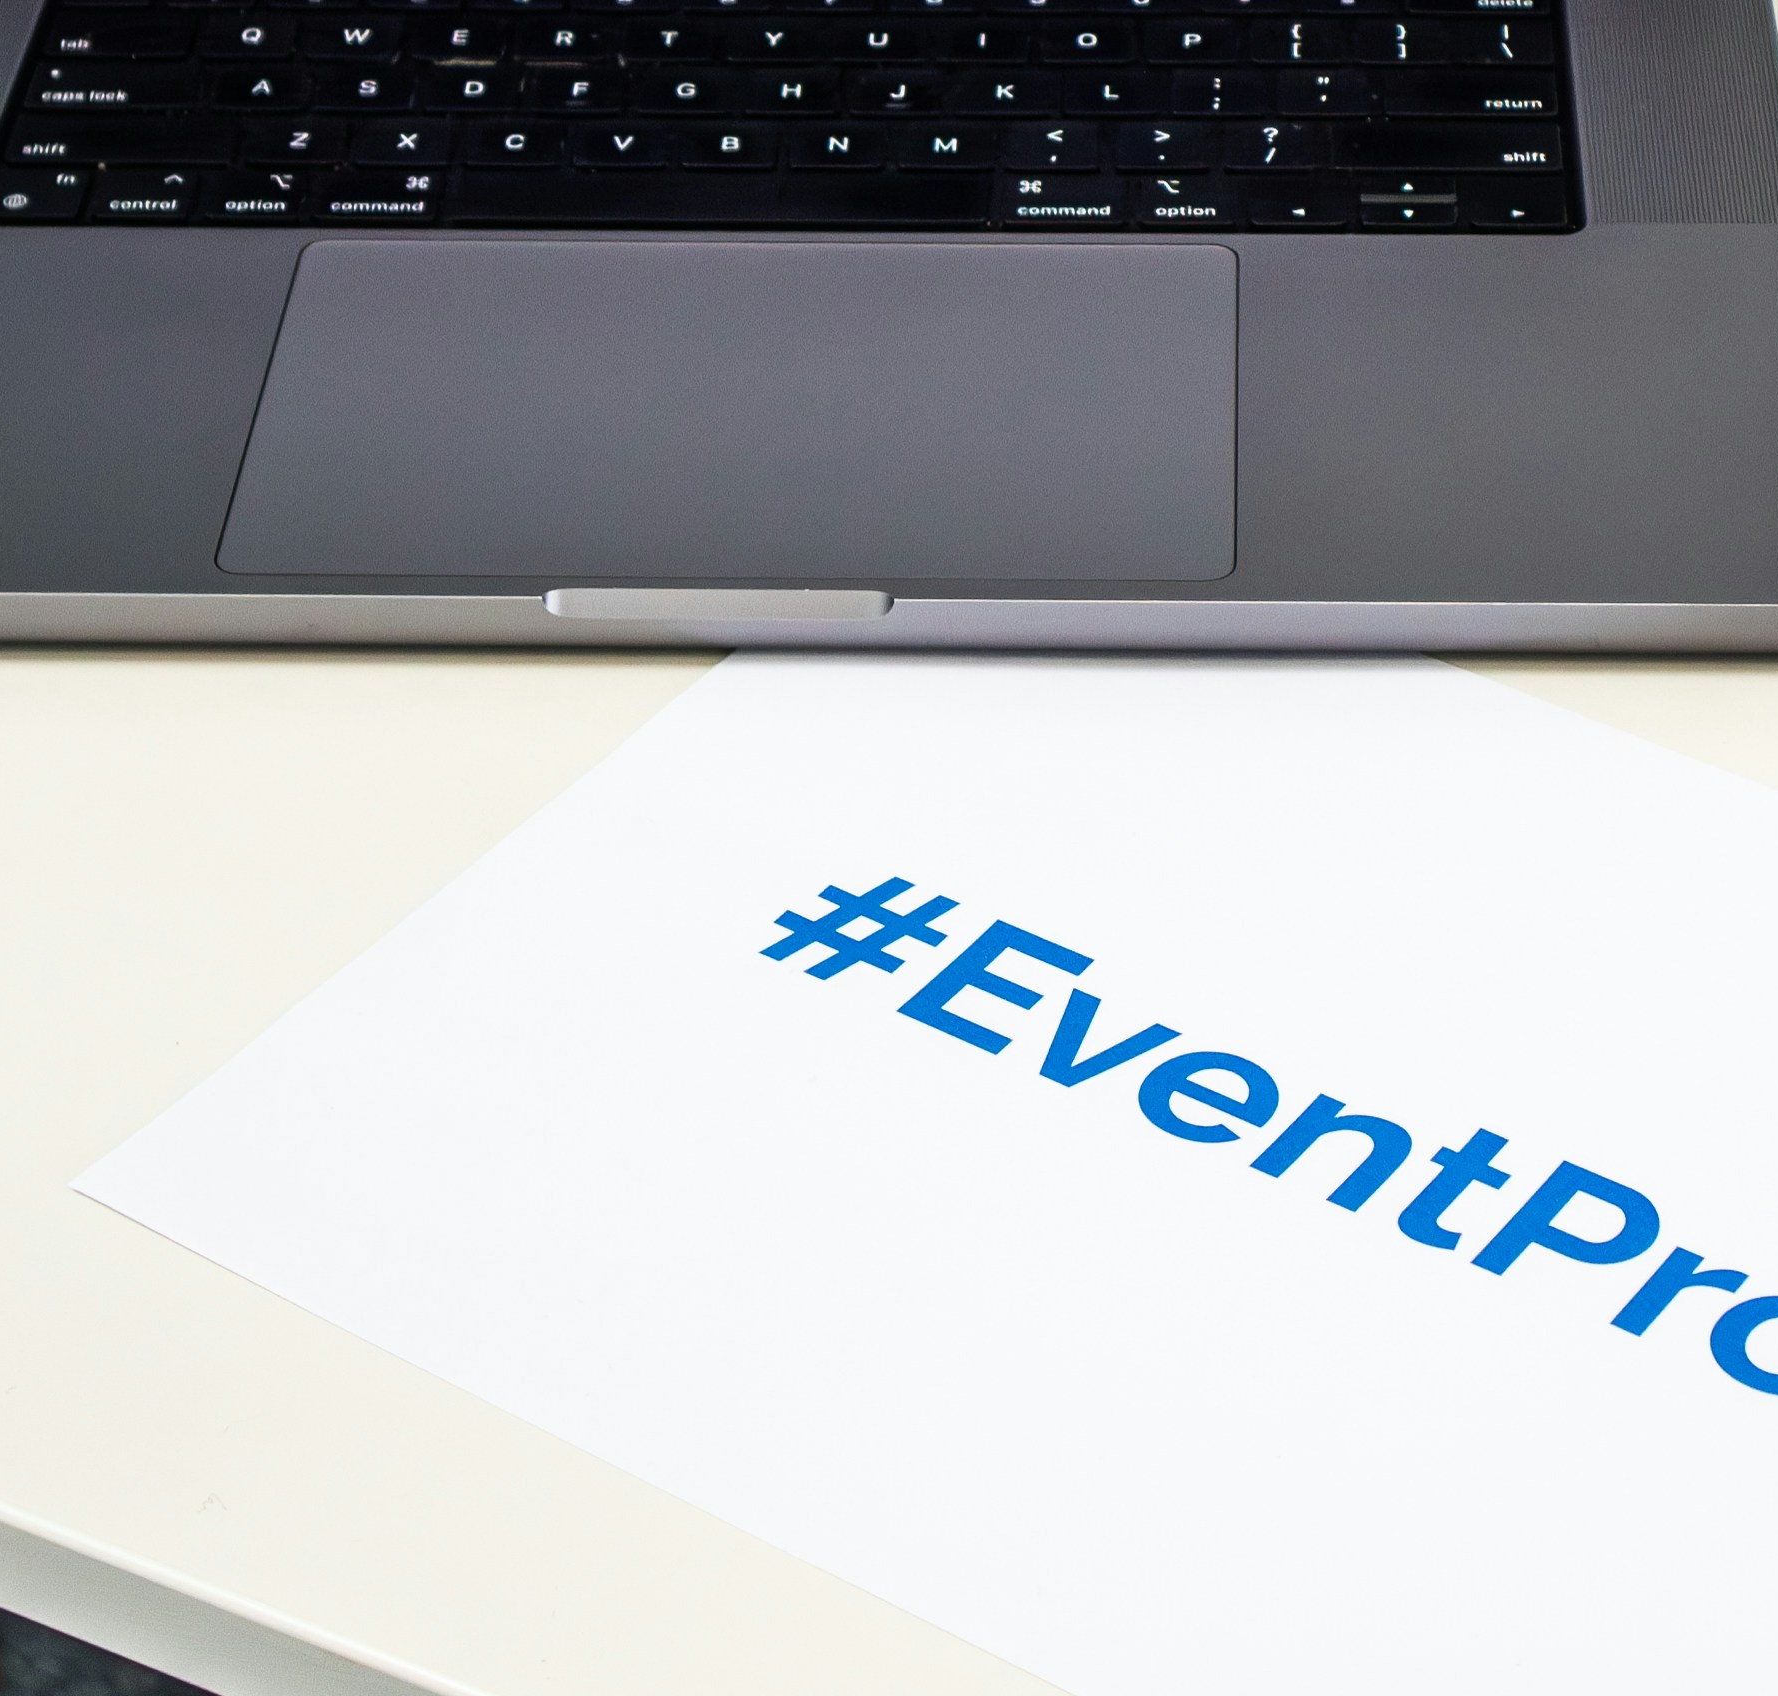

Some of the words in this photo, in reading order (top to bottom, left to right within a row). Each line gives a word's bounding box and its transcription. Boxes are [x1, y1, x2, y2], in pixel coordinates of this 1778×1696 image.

[41, 90, 85, 104] caps
[89, 88, 128, 102] lock
[1484, 98, 1543, 110] return
[22, 141, 67, 155] shift
[1502, 149, 1547, 163] shift
[109, 198, 178, 211] control
[224, 198, 287, 213] option
[330, 200, 424, 213] command
[1017, 204, 1111, 217] command
[1155, 204, 1217, 218] option
